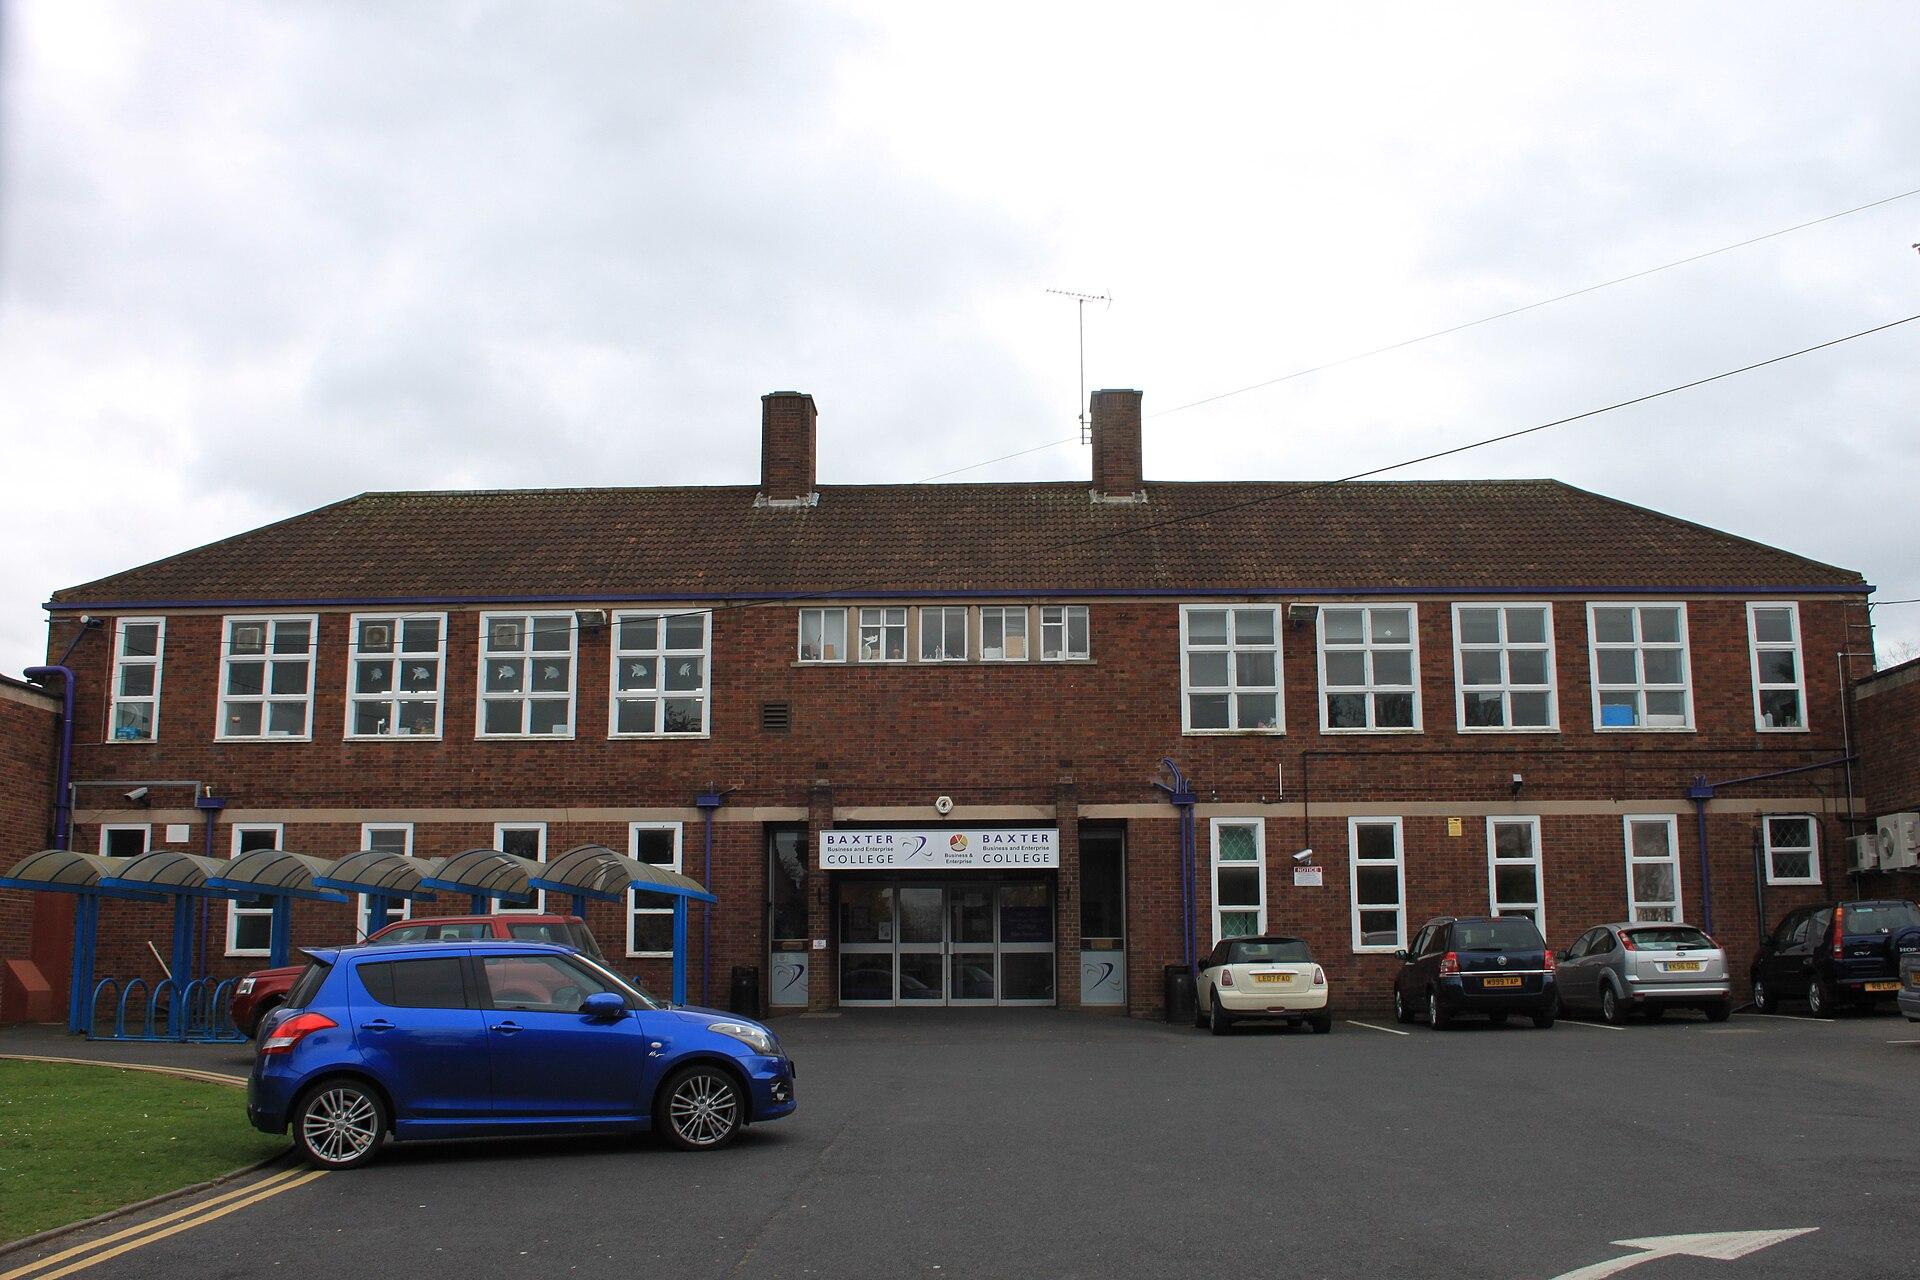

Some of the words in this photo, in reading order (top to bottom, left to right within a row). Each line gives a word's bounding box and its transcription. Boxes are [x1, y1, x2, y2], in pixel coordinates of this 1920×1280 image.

[827, 835, 894, 844] BAXTER
[982, 834, 1049, 843] BAXTER
[827, 855, 894, 864] COLLEGE
[982, 853, 1050, 863] COLLEGE
